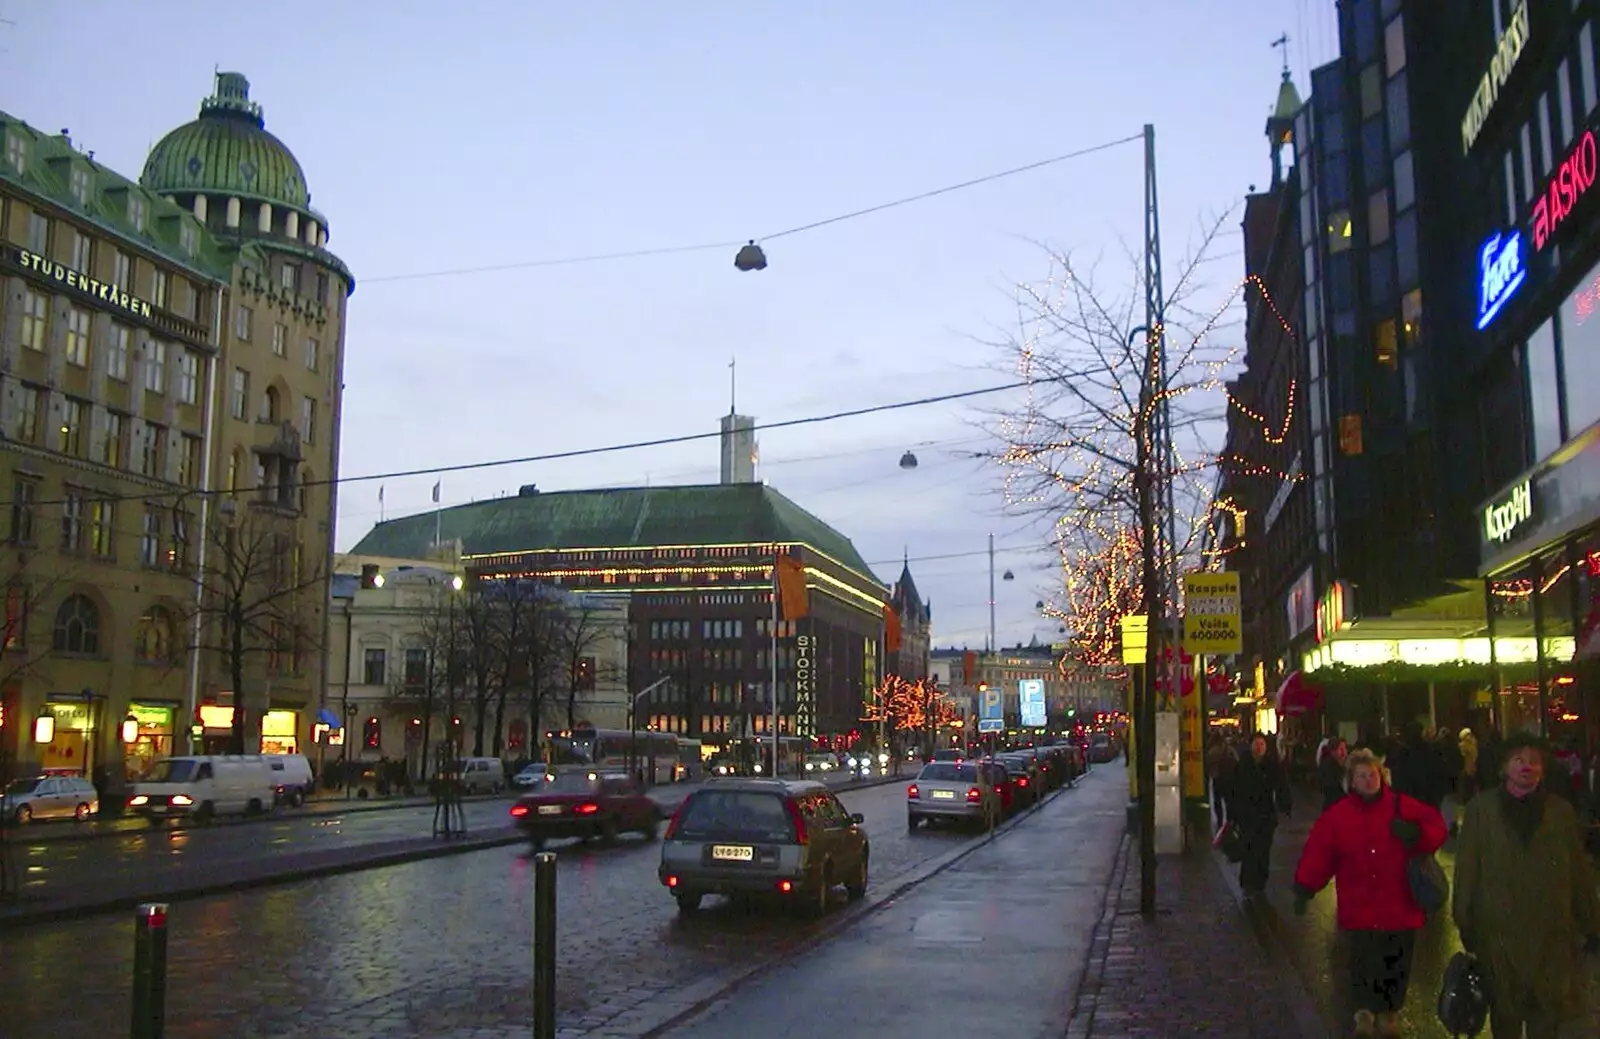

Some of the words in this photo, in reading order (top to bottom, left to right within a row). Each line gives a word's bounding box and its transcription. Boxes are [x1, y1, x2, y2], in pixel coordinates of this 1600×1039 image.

[1550, 130, 1598, 232] ASKO
[20, 250, 151, 318] STUDENTKÅREN
[797, 635, 810, 736] STOCKMANN
